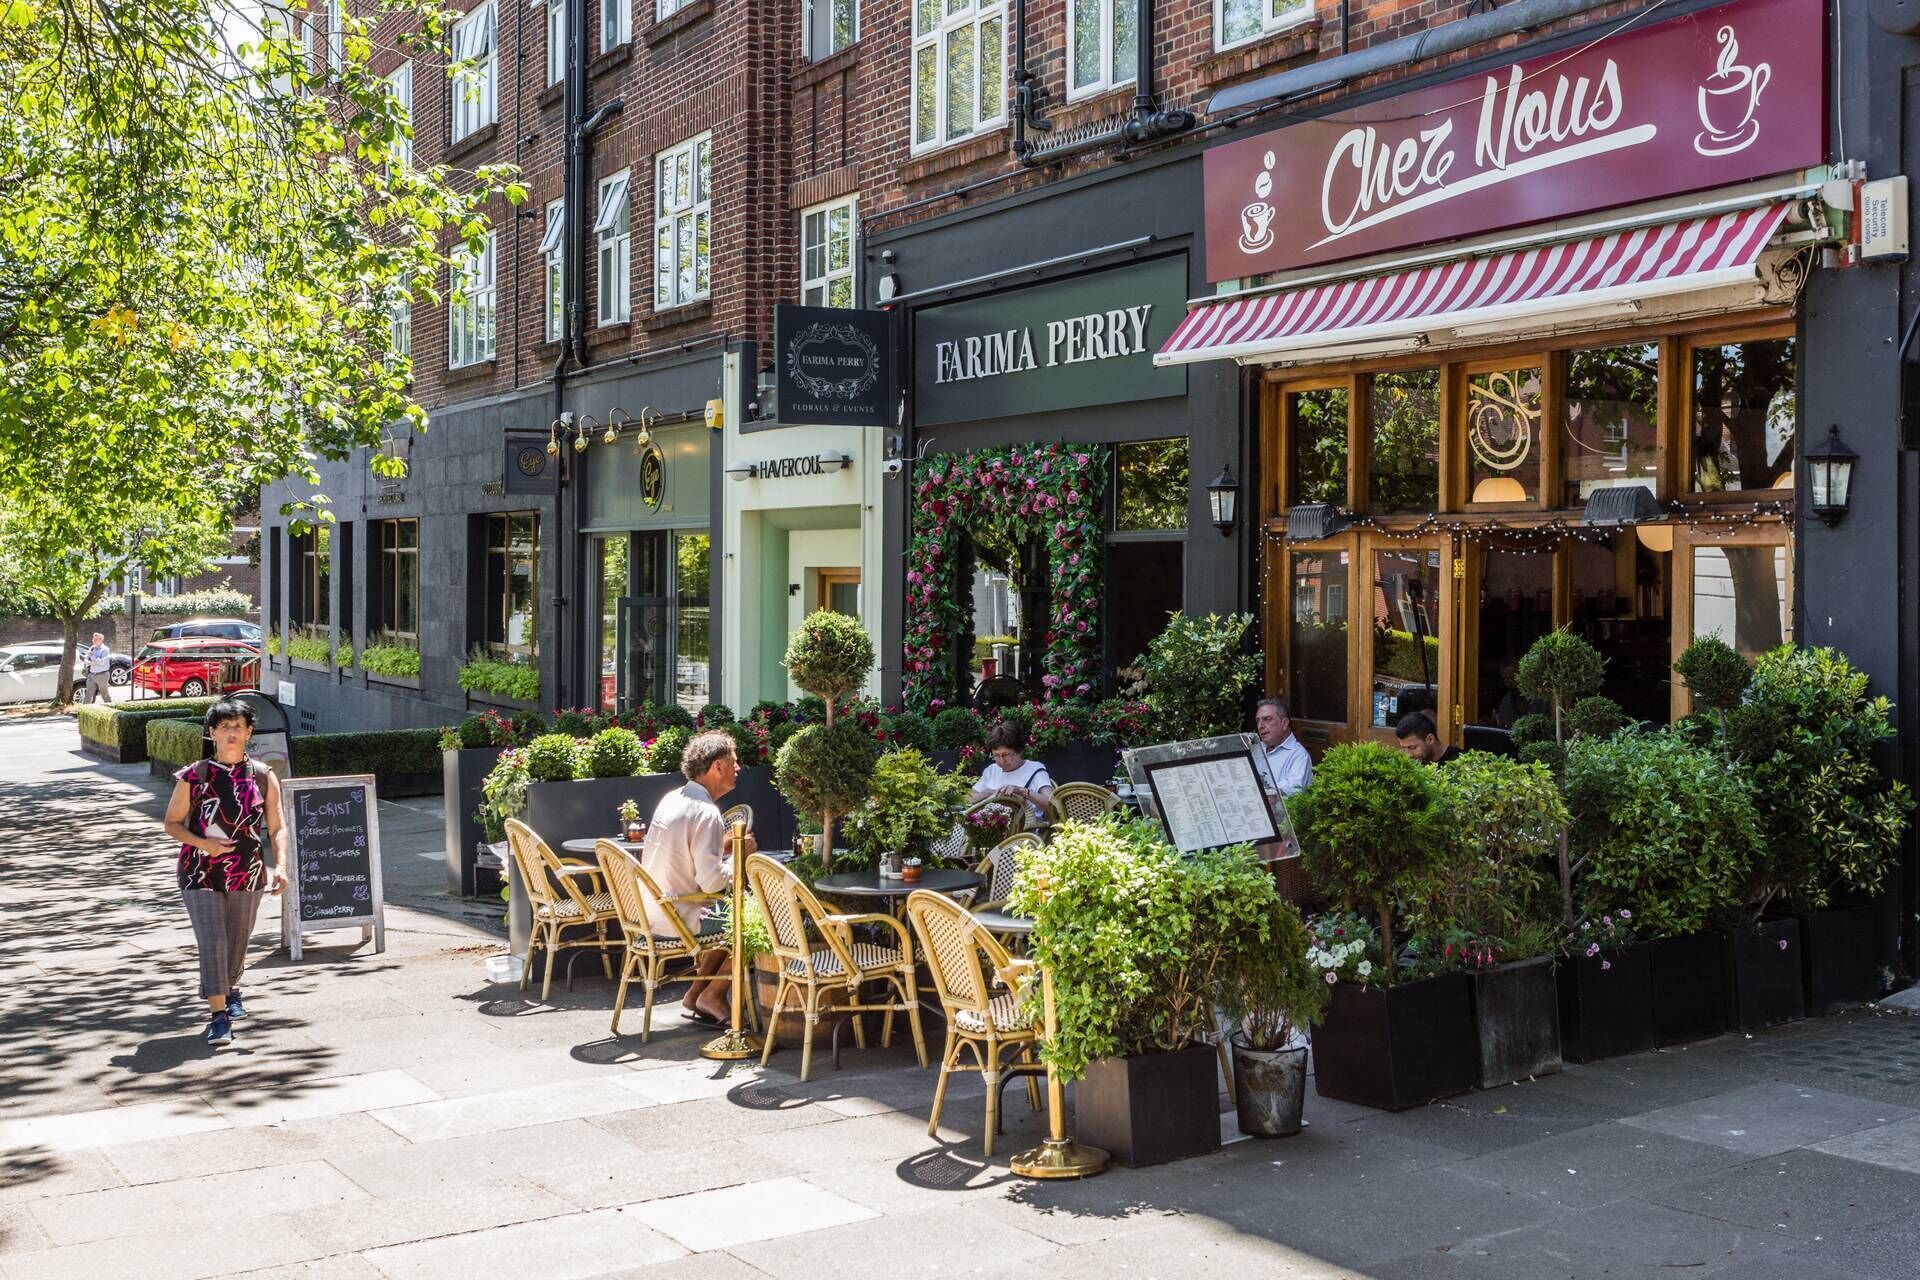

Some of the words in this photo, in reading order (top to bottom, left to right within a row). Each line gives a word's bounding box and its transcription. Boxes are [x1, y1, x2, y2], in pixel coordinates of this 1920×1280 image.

[1322, 118, 1454, 234] Chez
[1476, 59, 1622, 170] Nous
[1872, 199, 1880, 238] Security
[1880, 198, 1888, 237] Telecom
[935, 327, 1038, 384] FARIMA
[1046, 304, 1152, 368] PERRY
[802, 355, 835, 366] FARIMA
[837, 356, 865, 367] PERRY
[793, 403, 829, 412] FLORALS
[843, 404, 875, 413] EVENTS
[300, 794, 352, 817] FLORIST
[328, 847, 361, 858] FLOWERS
